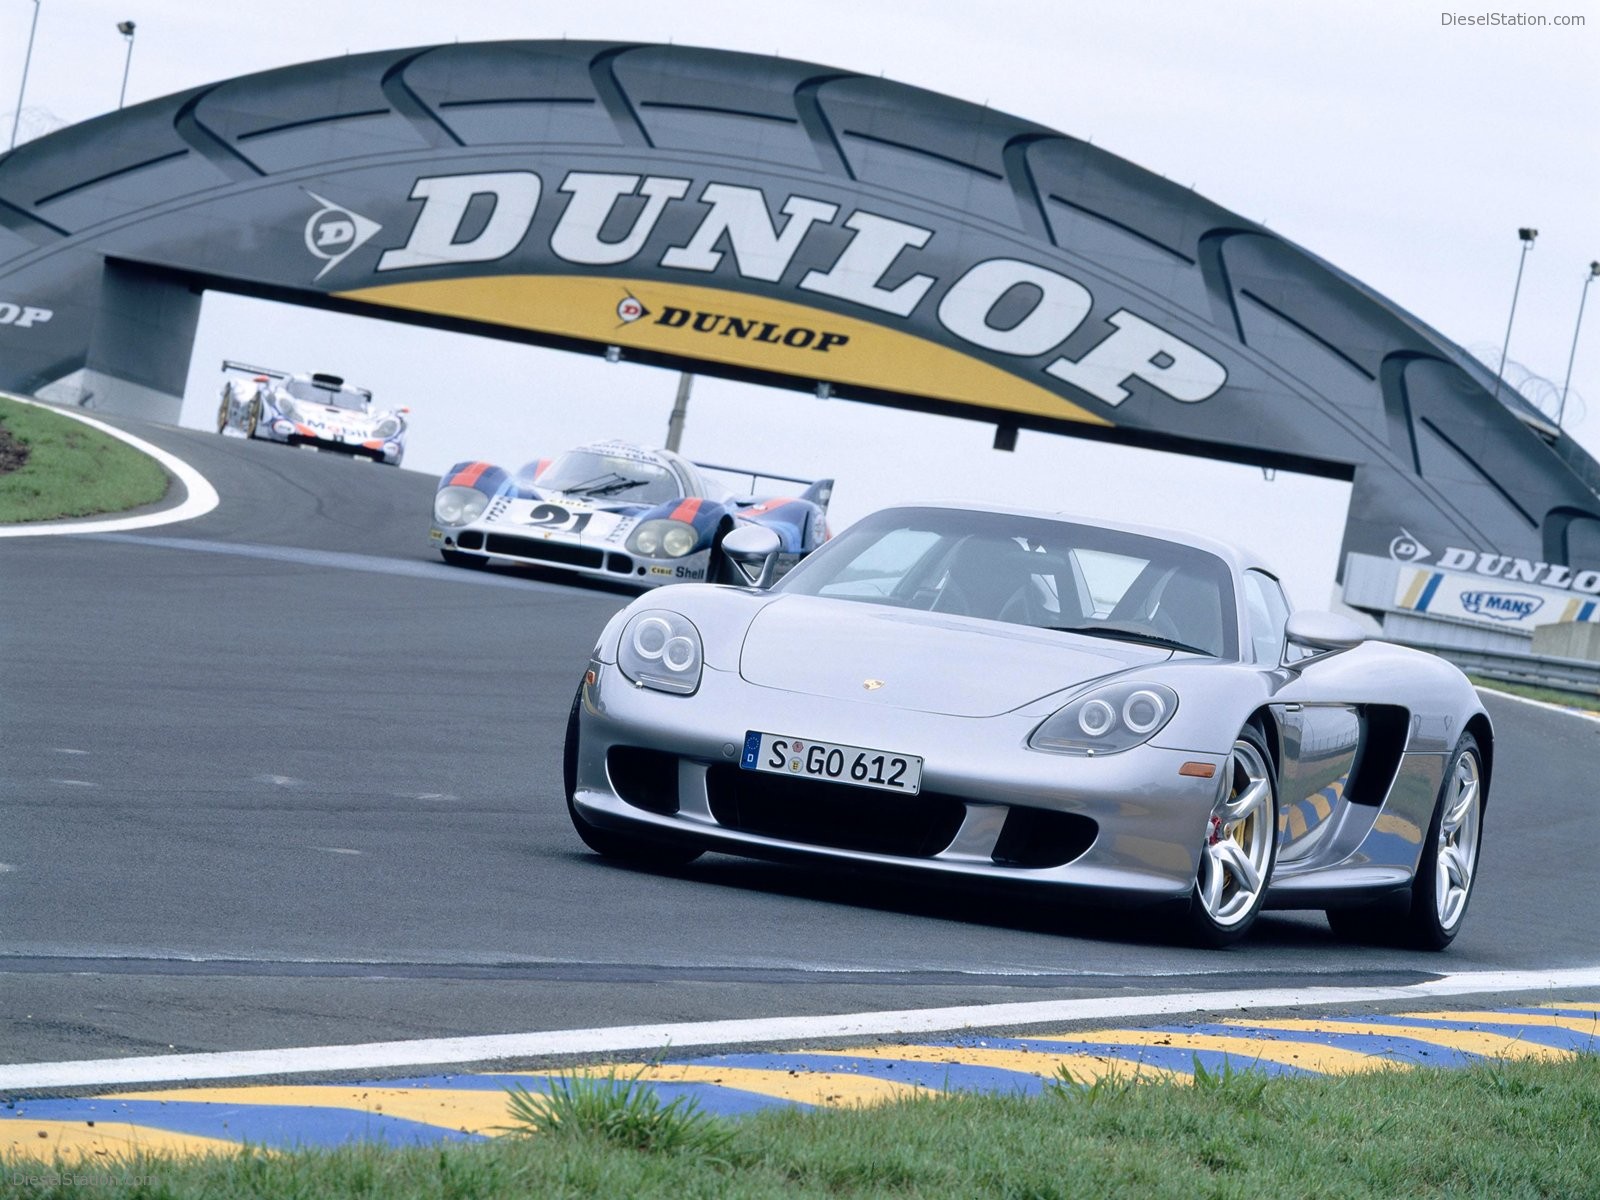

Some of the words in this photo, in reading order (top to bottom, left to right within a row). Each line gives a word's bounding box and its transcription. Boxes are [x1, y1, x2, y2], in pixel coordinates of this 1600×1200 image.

[316, 220, 355, 247] D
[374, 170, 1228, 408] DUNLOP
[621, 304, 640, 316] D
[654, 305, 850, 352] DUNLOP
[306, 419, 369, 438] Mobil
[525, 503, 594, 534] 21
[1396, 542, 1417, 555] D
[675, 566, 705, 580] Shell
[1485, 596, 1533, 615] MANS
[746, 753, 754, 762] D
[768, 740, 788, 769] S
[806, 745, 844, 777] GO
[851, 752, 907, 787] 612
